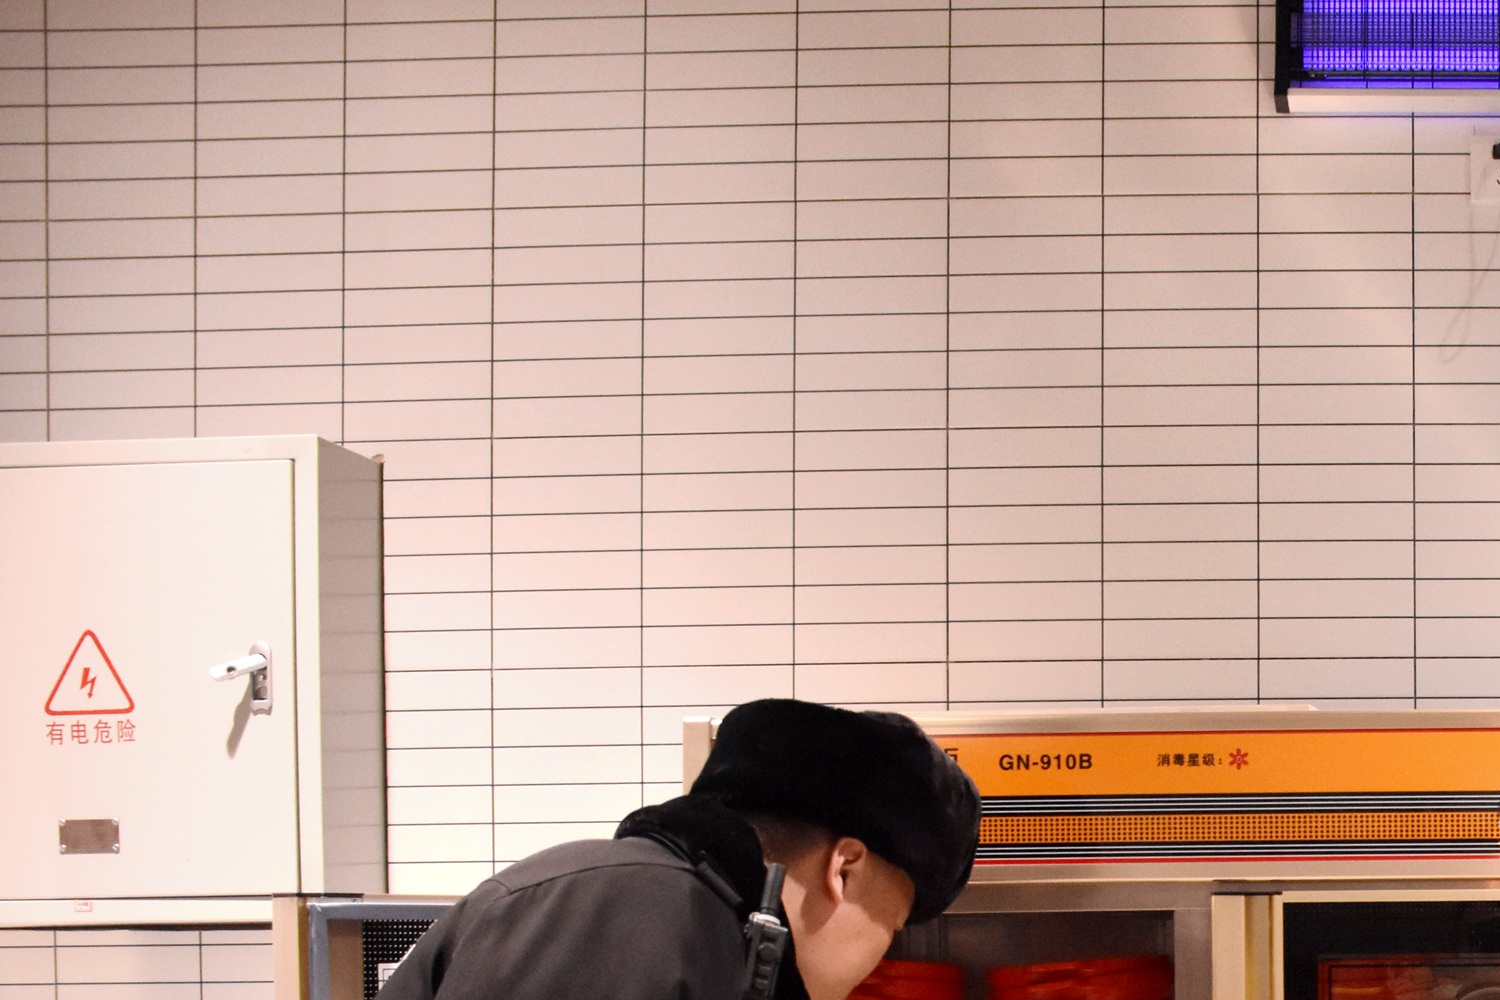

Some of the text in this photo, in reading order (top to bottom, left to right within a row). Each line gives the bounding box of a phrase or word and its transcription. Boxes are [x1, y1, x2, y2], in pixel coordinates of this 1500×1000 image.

[46, 719, 136, 746] 有电危险
[999, 753, 1093, 771] GN-910B
